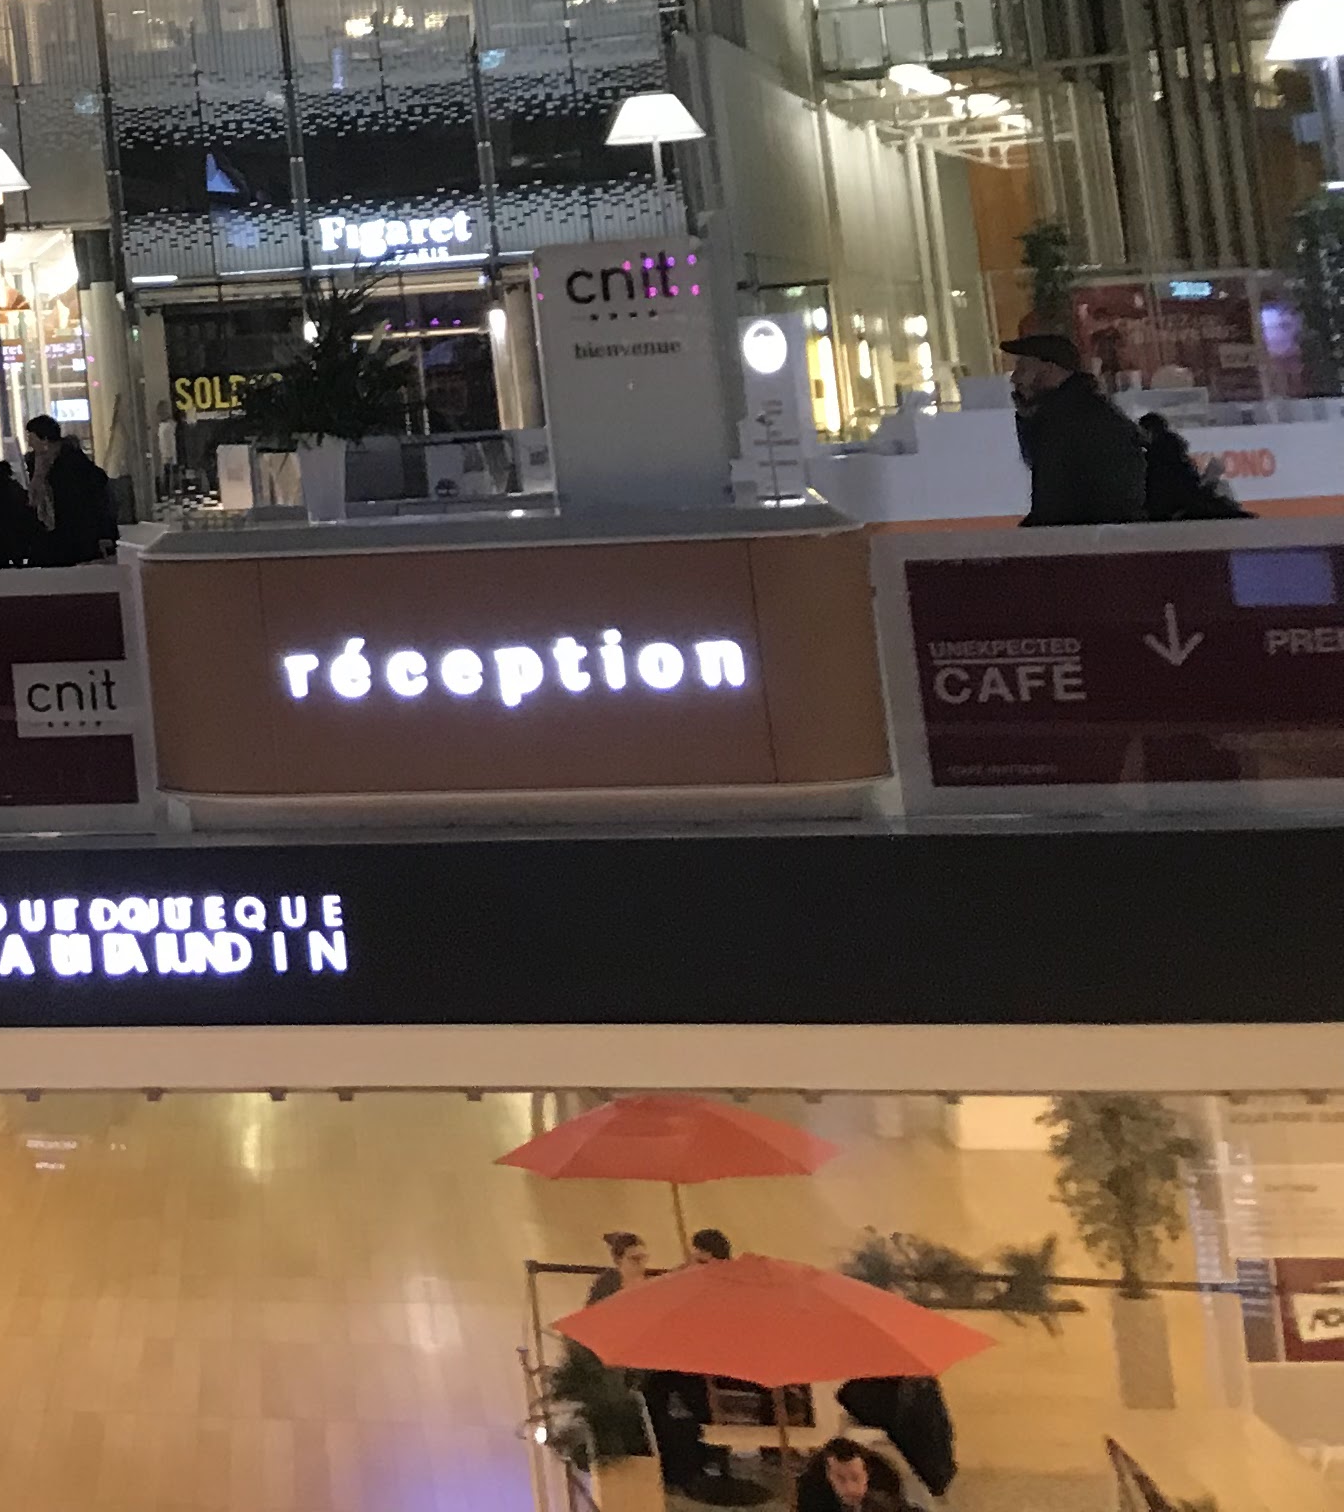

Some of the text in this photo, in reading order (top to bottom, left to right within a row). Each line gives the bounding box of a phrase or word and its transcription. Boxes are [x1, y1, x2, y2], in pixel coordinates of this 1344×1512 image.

[319, 210, 472, 257] Figaret
[566, 250, 676, 304] cnit
[284, 628, 746, 707] réception
[928, 638, 1082, 658] UNEXPECTED
[28, 669, 117, 712] cnit
